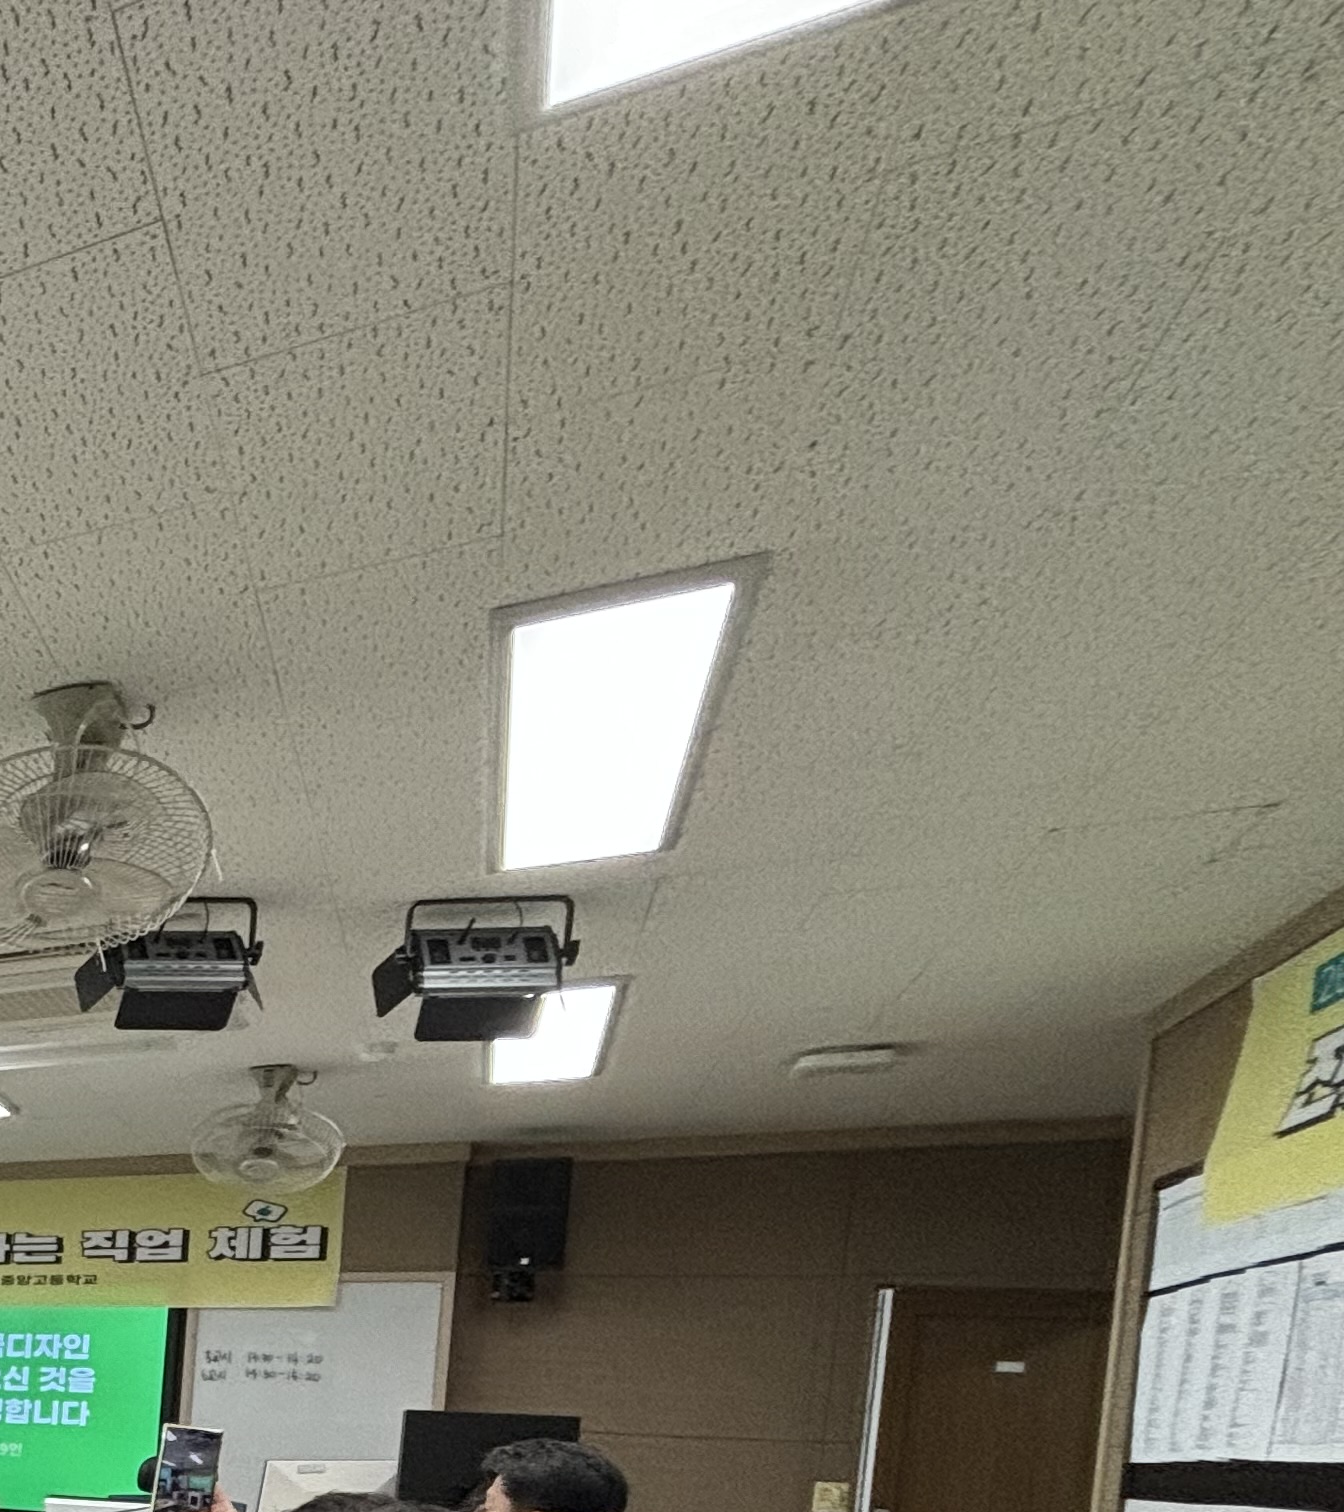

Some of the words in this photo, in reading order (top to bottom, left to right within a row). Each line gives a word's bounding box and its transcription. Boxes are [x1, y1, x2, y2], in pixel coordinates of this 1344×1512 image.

[82, 1228, 190, 1263] 직업
[209, 1225, 327, 1261] 체험
[39, 1366, 96, 1394] 것을
